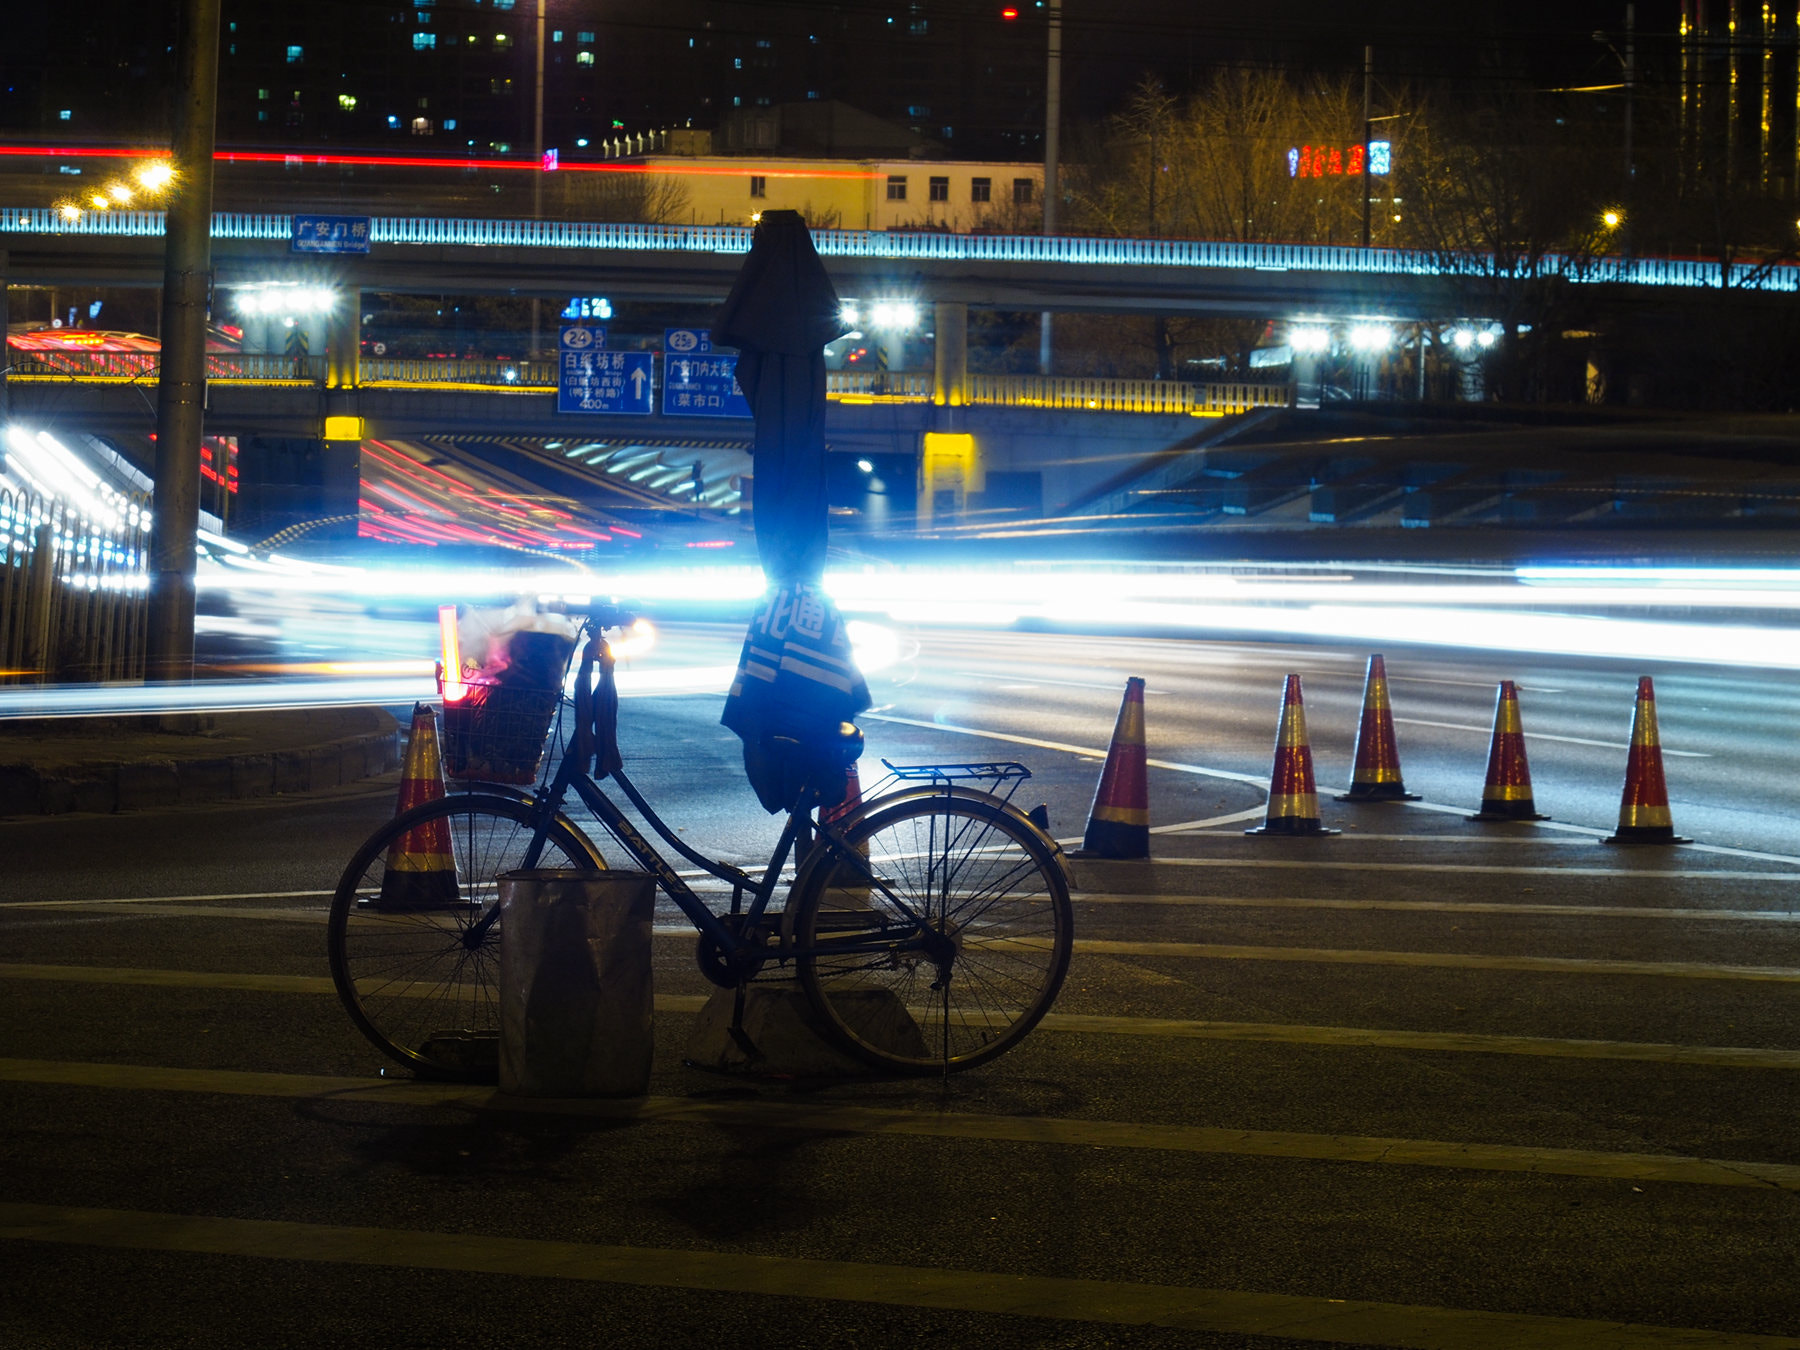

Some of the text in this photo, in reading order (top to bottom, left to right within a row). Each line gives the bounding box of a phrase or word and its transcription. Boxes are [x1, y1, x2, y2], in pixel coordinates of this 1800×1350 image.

[297, 220, 366, 237] 广安门桥
[569, 331, 586, 345] 24
[565, 353, 625, 370] 白纸坊桥
[617, 820, 677, 885] BATTLE
